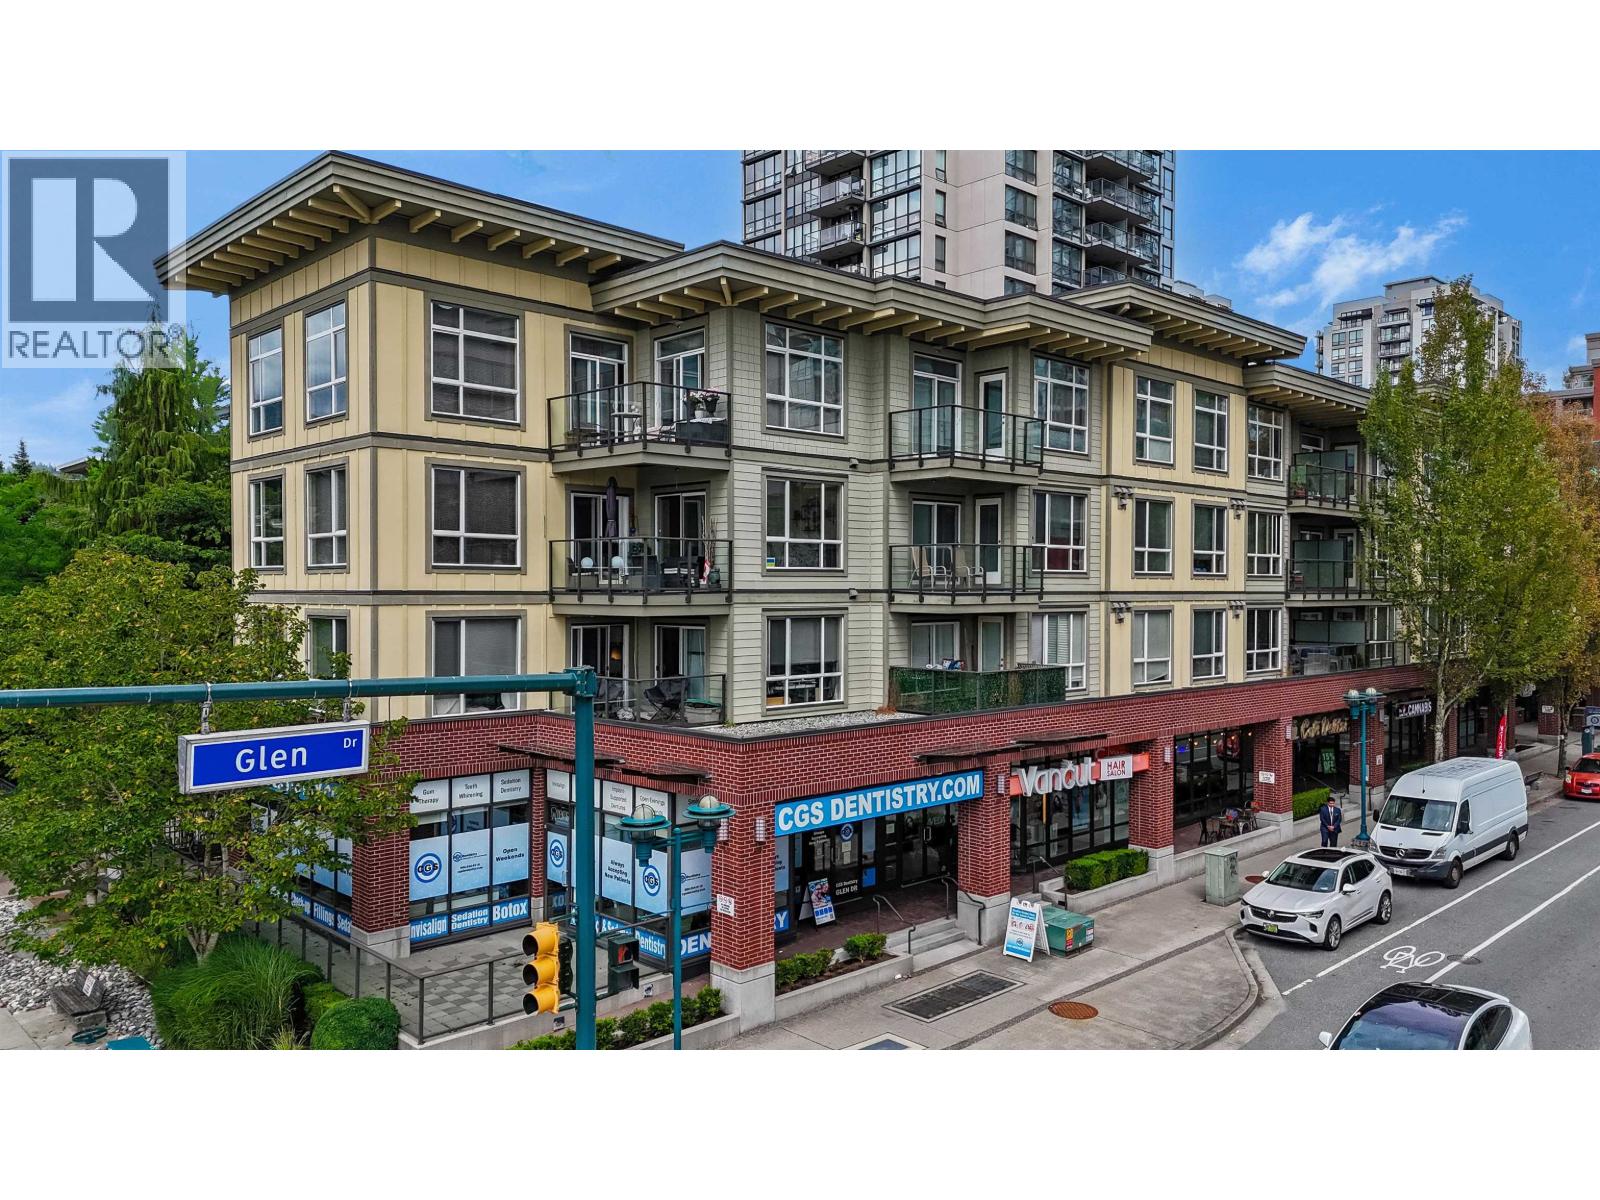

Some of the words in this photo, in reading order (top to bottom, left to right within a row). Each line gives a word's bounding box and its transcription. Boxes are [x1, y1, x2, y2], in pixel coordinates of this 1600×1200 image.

[235, 745, 307, 773] Glen
[343, 737, 358, 749] Dr
[1107, 760, 1126, 771] HAIR
[1107, 769, 1126, 777] SALON
[778, 801, 825, 831] CGS
[830, 774, 980, 821] DENTISTRY.COM
[495, 852, 525, 862] Weekends
[417, 863, 439, 873] CGS
[607, 867, 628, 878] Accepting
[604, 872, 613, 880] New
[613, 874, 631, 886] Patients
[835, 887, 850, 895] GLEN
[313, 902, 335, 927] Fillings
[451, 908, 488, 923] Sedation
[493, 901, 529, 921] Botox
[411, 916, 447, 939] nvisalign
[451, 916, 488, 930] Dentistry
[635, 928, 666, 959] Dentistry
[681, 932, 712, 955] DEN
